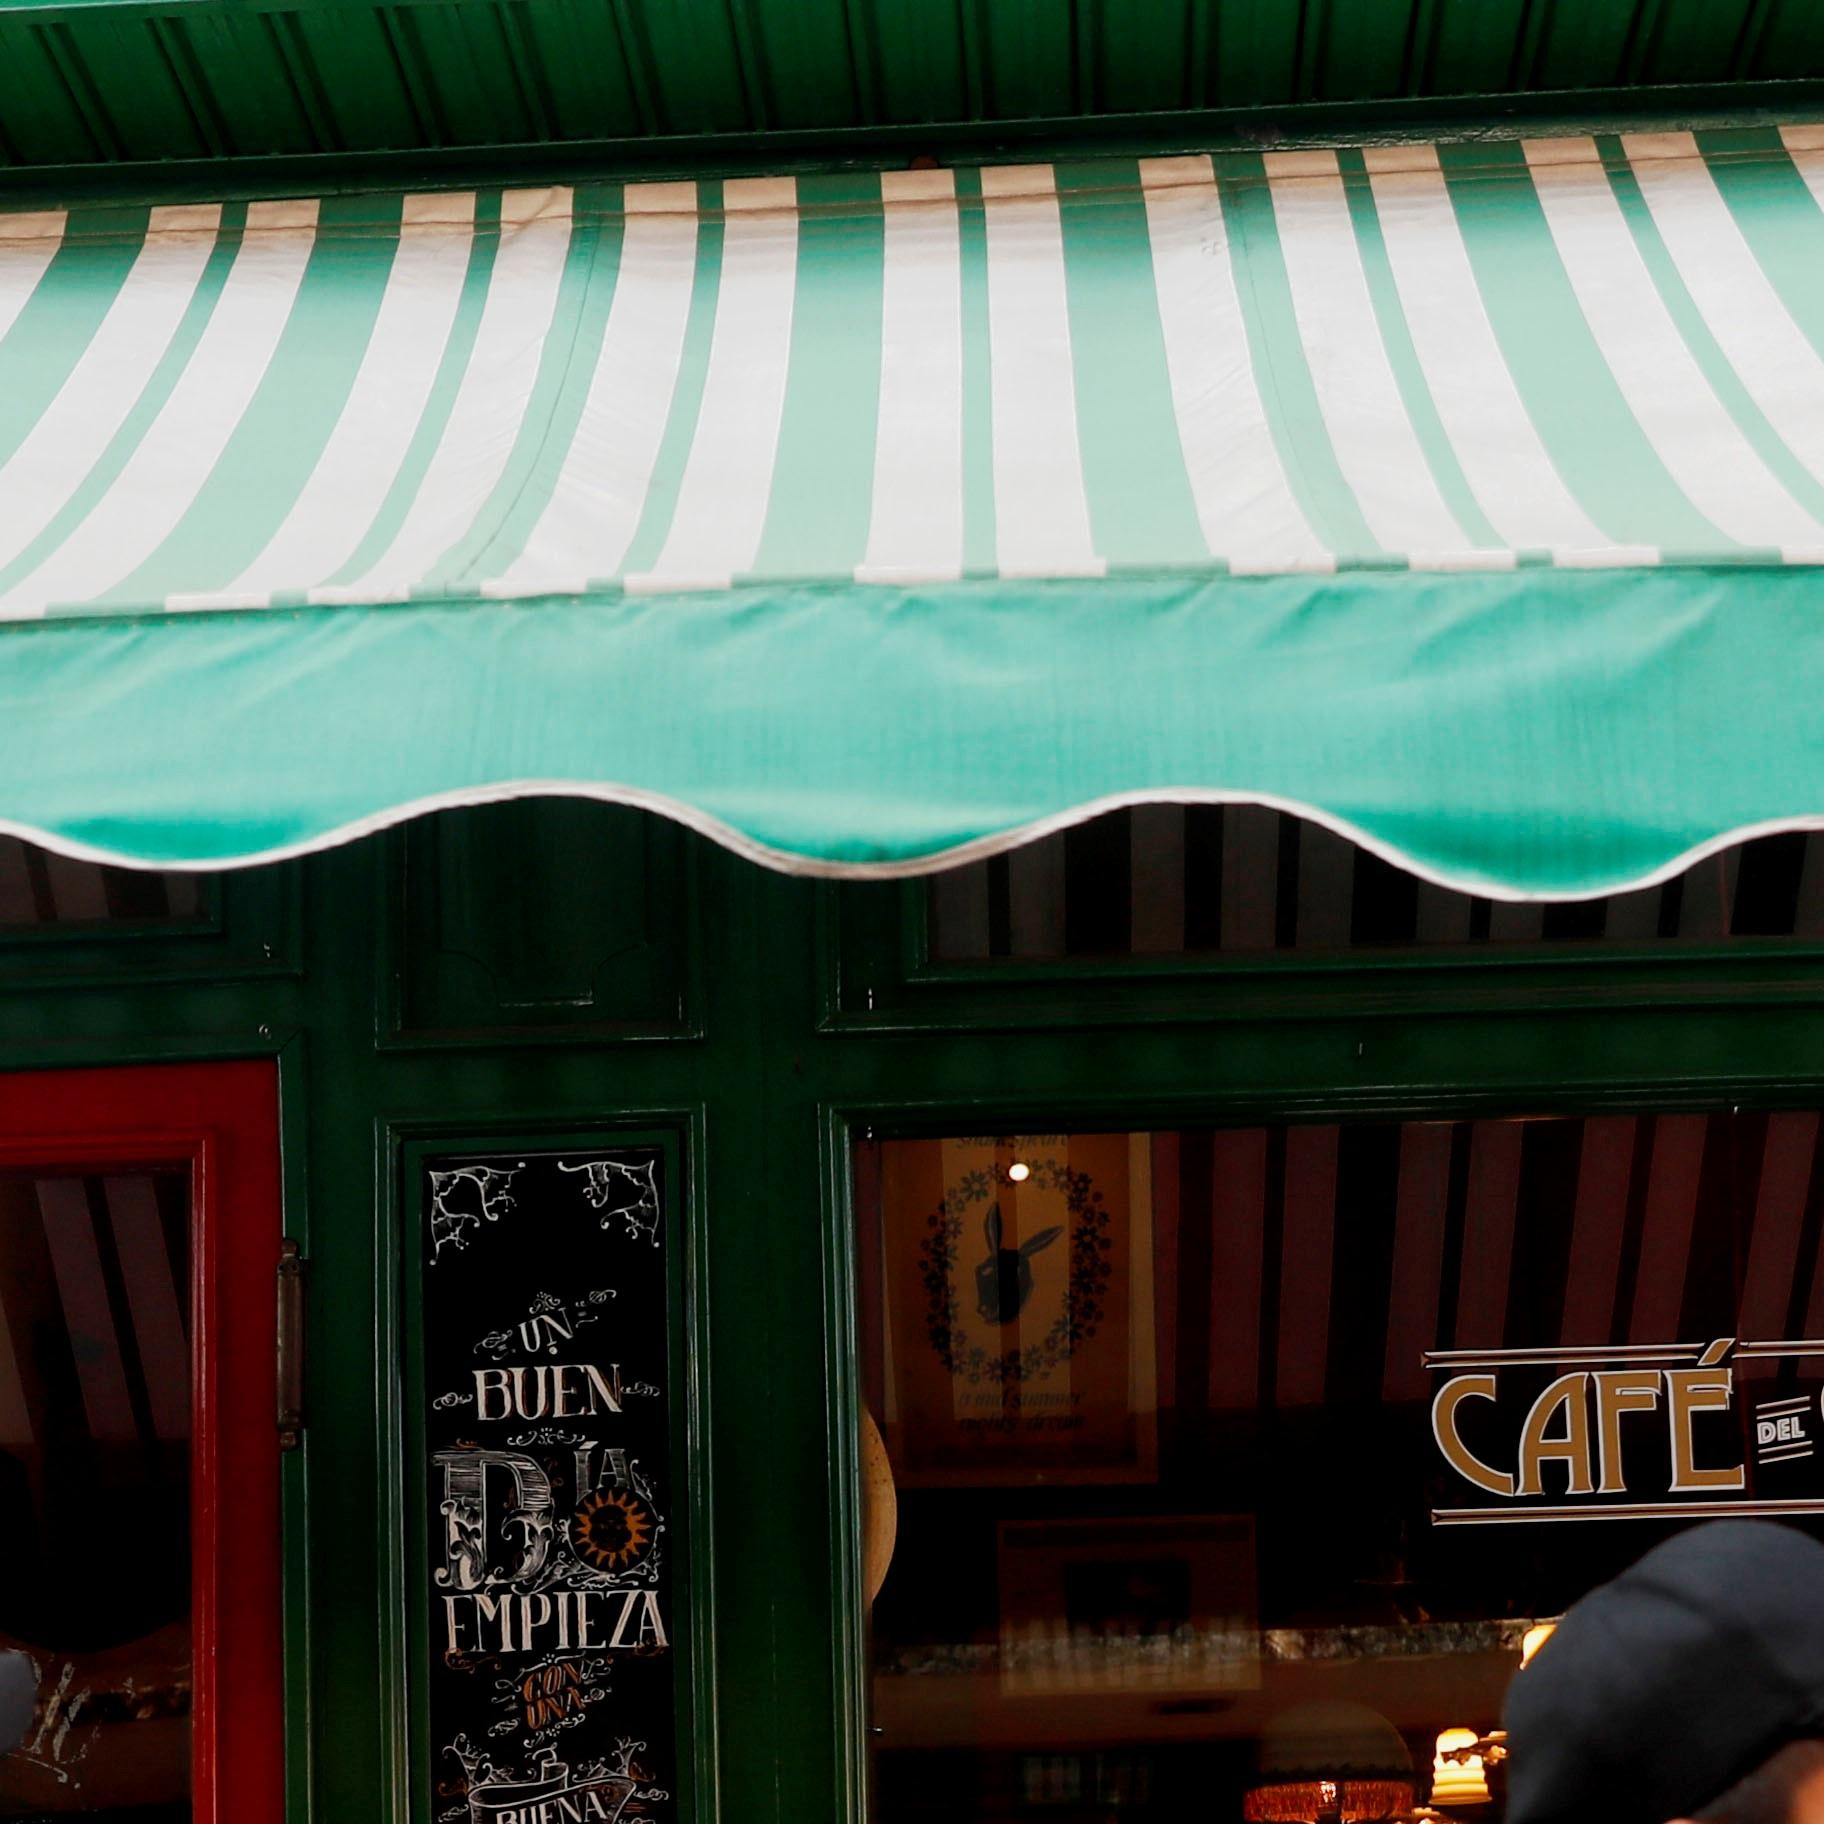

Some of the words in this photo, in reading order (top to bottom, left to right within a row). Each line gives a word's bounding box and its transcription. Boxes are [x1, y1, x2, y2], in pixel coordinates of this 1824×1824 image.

[518, 1307, 574, 1353] UN
[472, 1363, 624, 1421] BUEN
[1431, 1338, 1747, 1497] CAFÉ
[1756, 1414, 1806, 1445] DEL
[441, 1590, 670, 1653] EMPIEZA
[523, 1662, 585, 1702] CON
[526, 1687, 586, 1730] UNA
